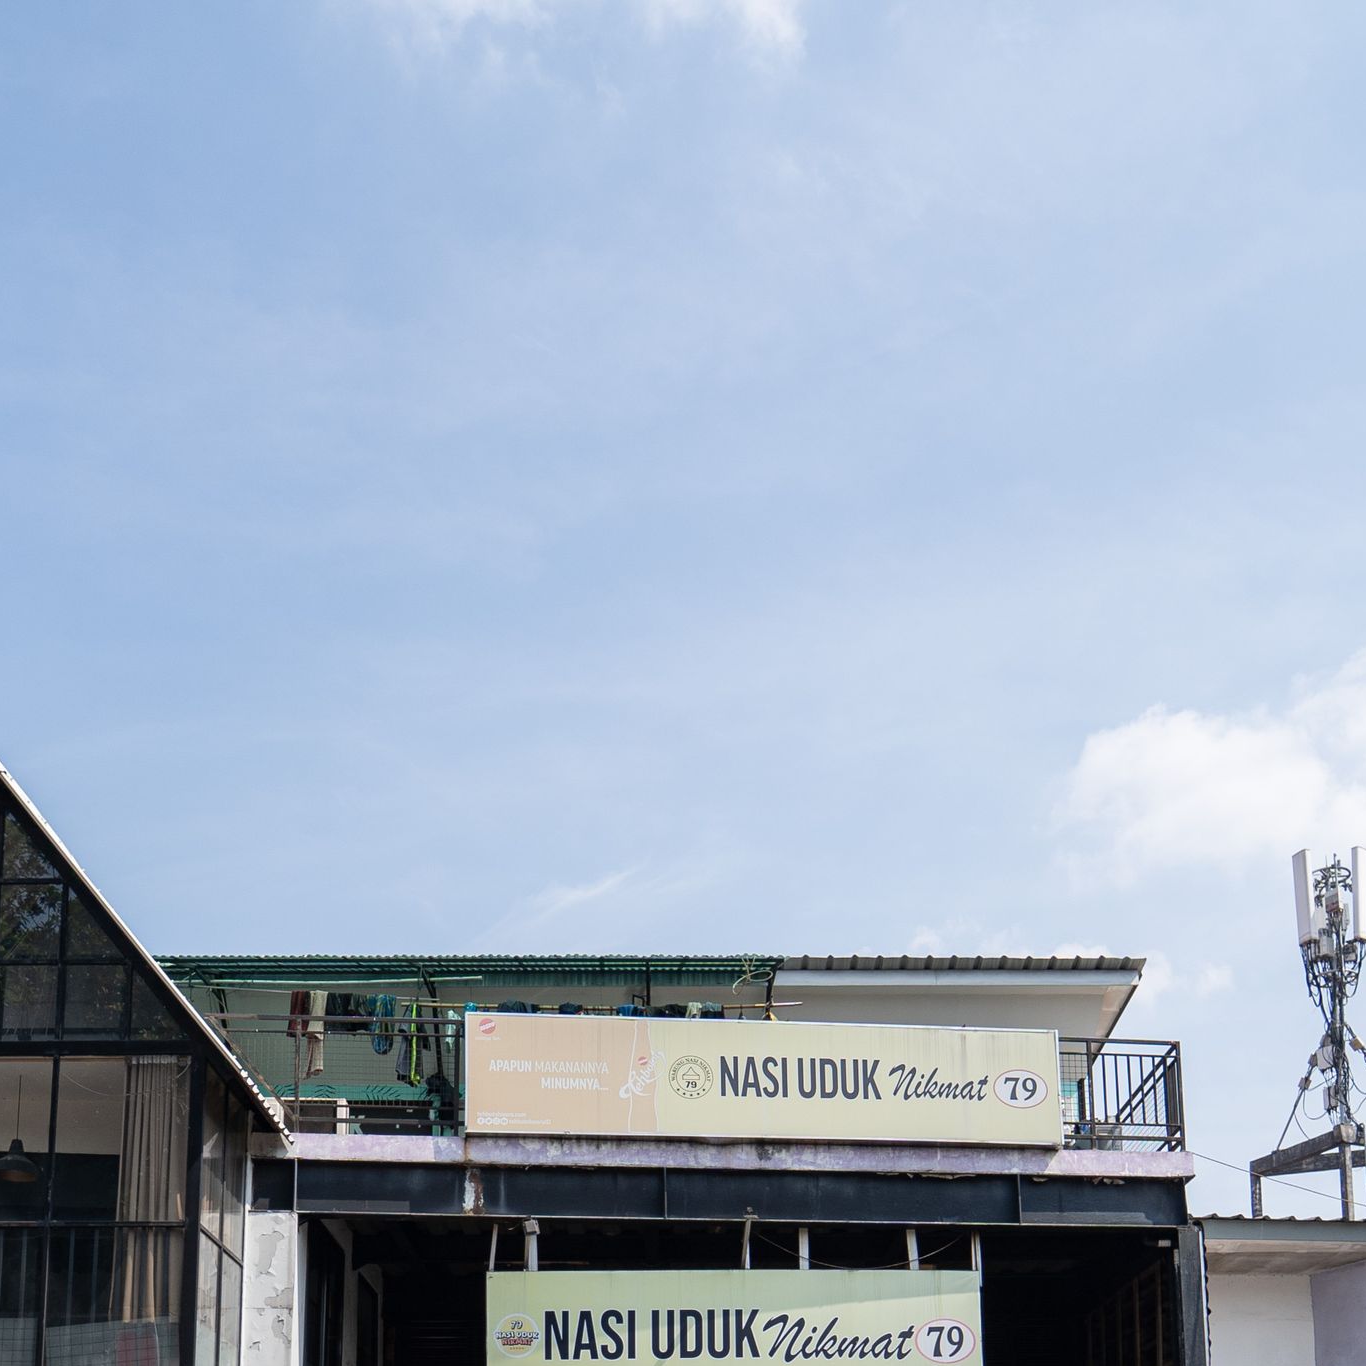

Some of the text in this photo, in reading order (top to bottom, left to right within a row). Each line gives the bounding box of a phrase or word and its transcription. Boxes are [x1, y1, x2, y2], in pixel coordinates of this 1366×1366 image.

[489, 1059, 609, 1074] APAPUN MAKANANNYA
[685, 1080, 697, 1089] 79
[720, 1055, 1039, 1103] NASI UDUK Nikmat 79
[511, 1320, 523, 1330] 79
[495, 1331, 539, 1340] NASI UDUK
[544, 1308, 964, 1364] NASI UDUK Nikmat 79
